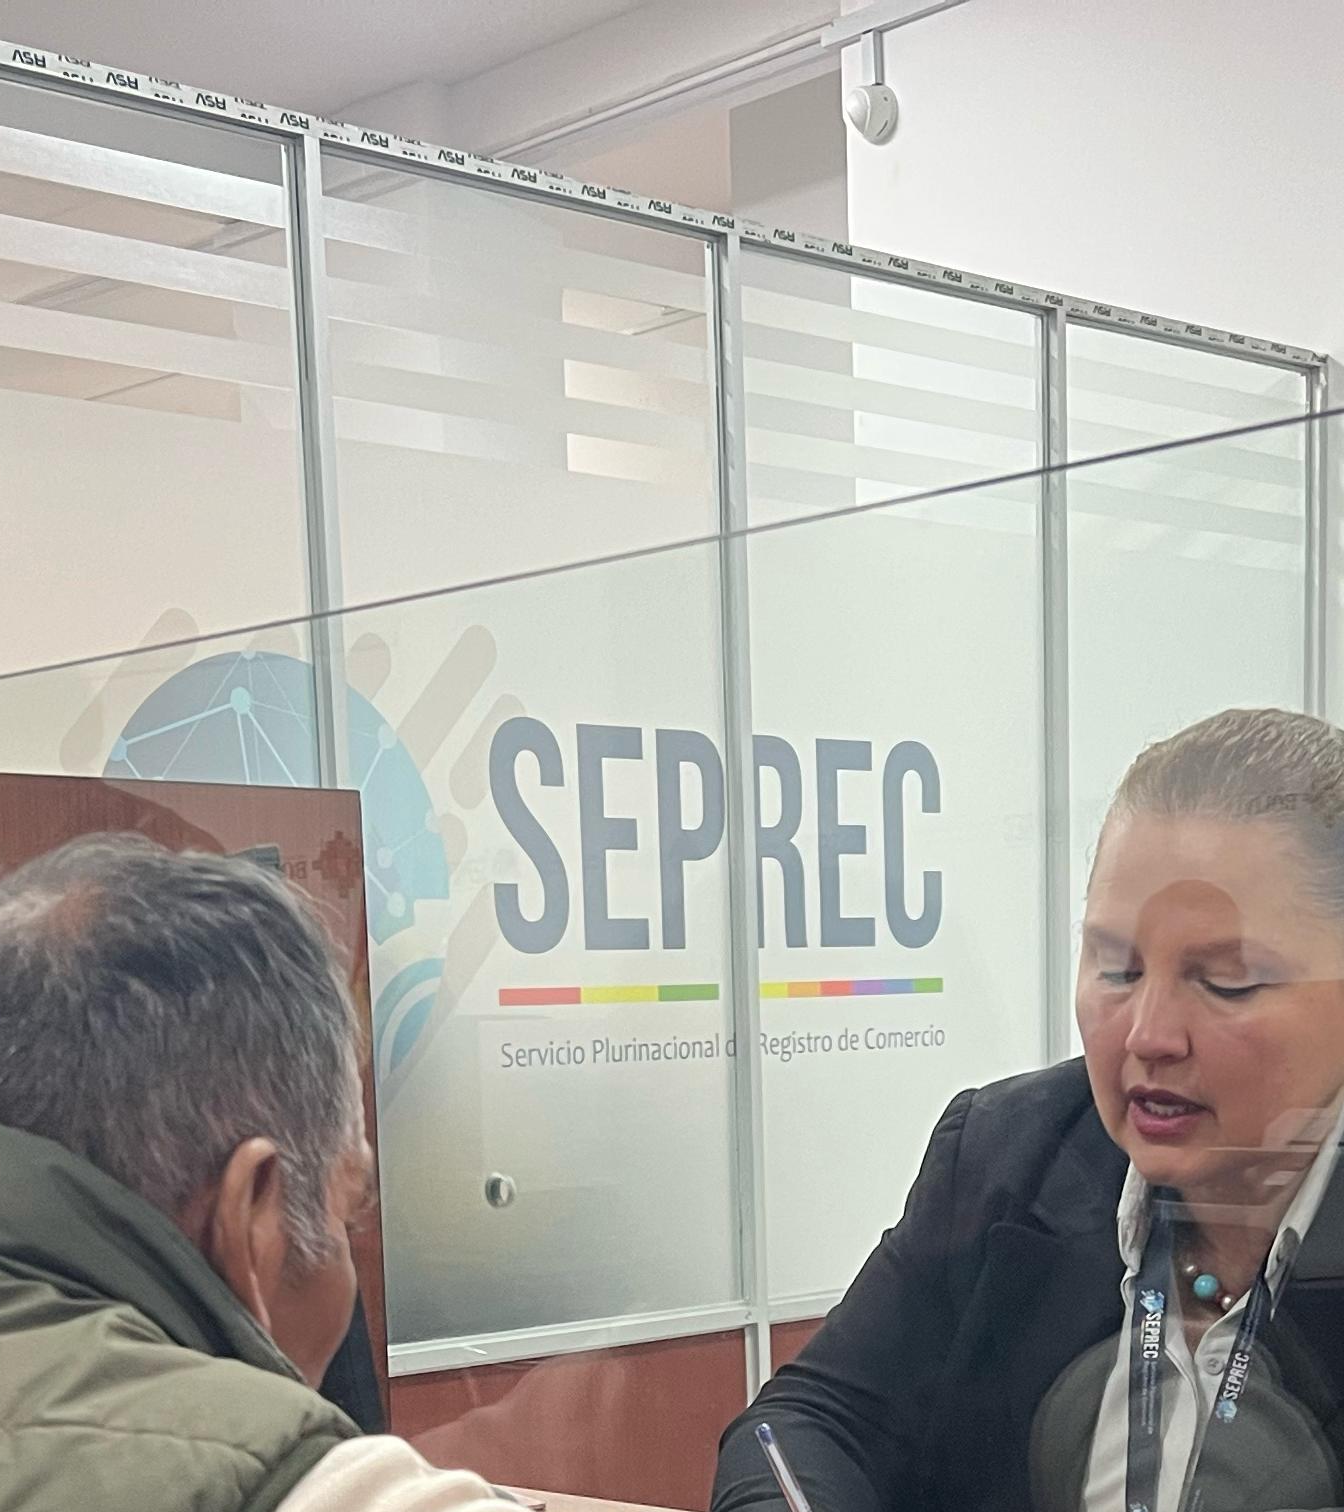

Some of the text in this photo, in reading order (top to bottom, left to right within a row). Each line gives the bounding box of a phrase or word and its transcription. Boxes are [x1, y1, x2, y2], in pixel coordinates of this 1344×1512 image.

[12, 49, 46, 69] RSV
[106, 71, 138, 90] RSV
[195, 92, 227, 111] RSV
[489, 716, 943, 954] SEPREC
[500, 1040, 586, 1068] Servicio
[592, 1033, 721, 1065] Plurinacional
[759, 1031, 834, 1062] Registro
[837, 1027, 860, 1053] de
[864, 1024, 946, 1050] Comercio
[1142, 1312, 1162, 1359] SEPREC
[1223, 1351, 1251, 1400] SEPREC
